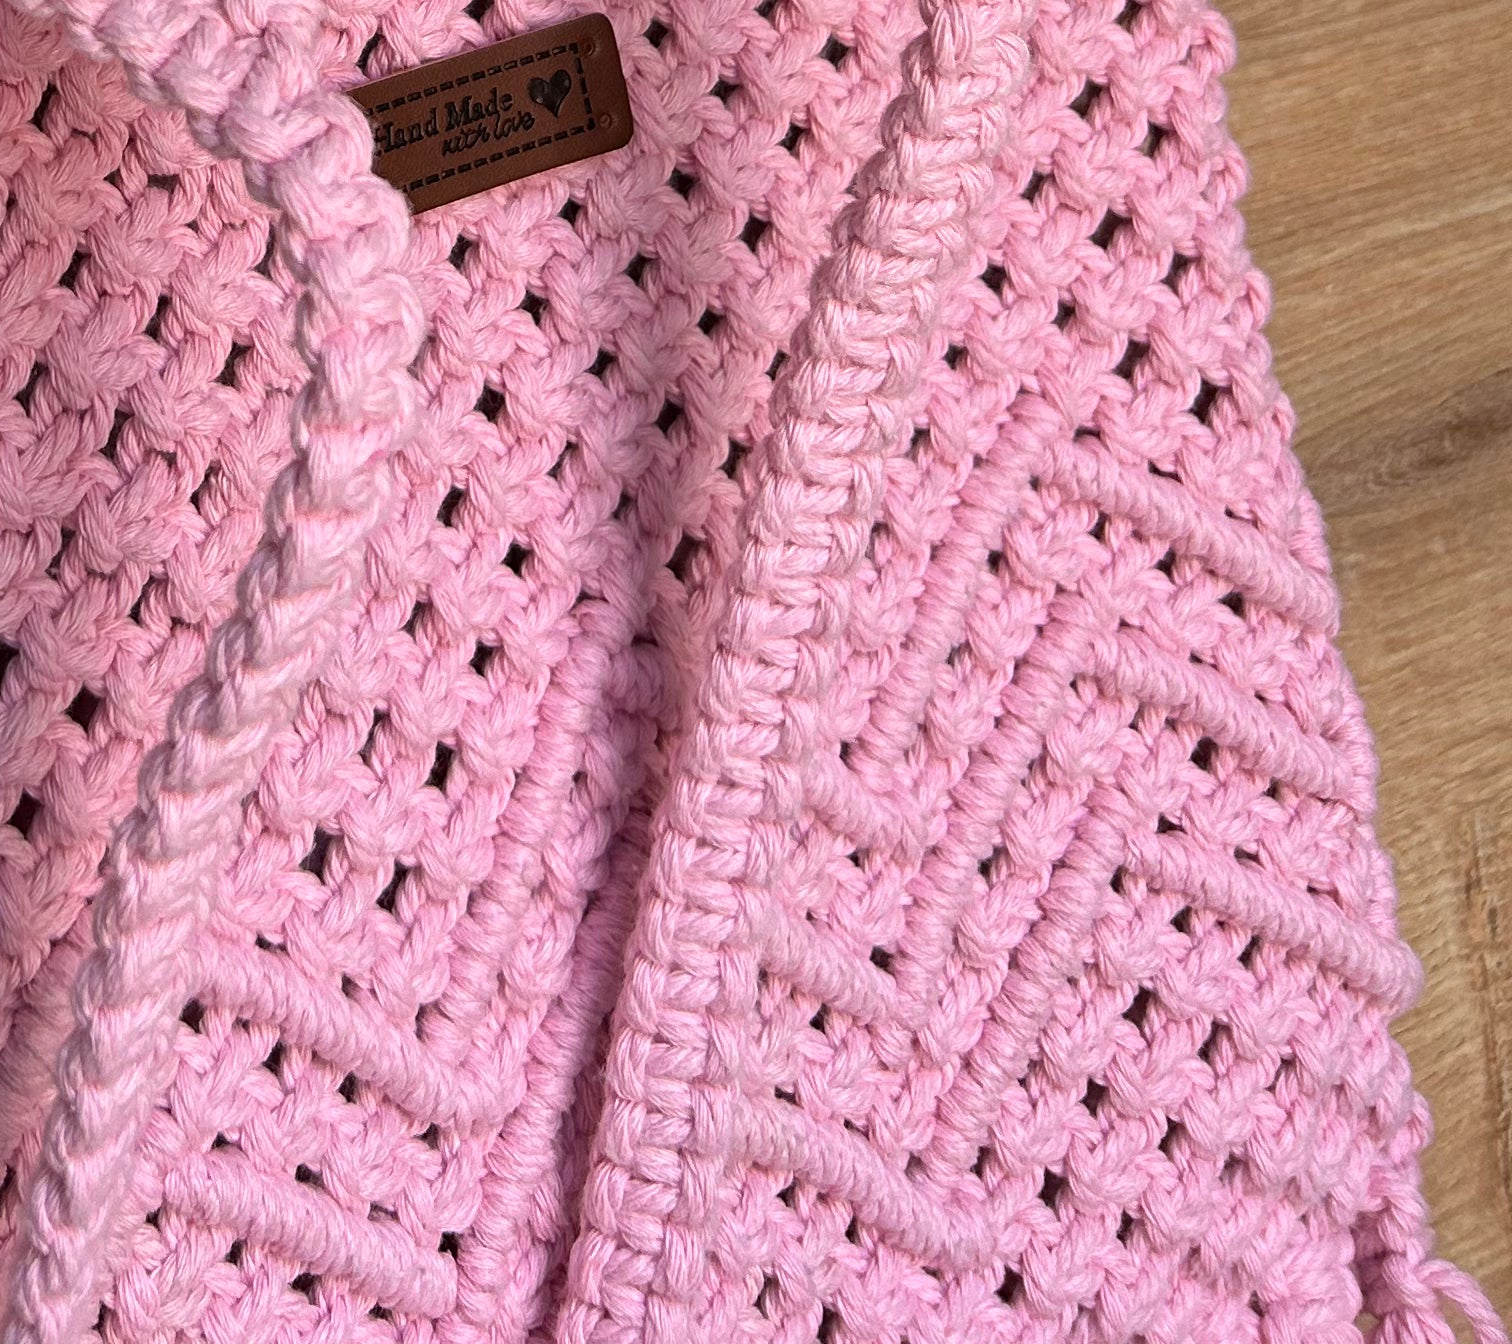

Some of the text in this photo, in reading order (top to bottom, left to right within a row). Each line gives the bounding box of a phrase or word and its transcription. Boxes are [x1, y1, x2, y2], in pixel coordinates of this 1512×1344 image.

[374, 85, 514, 156] Hand Made
[493, 109, 535, 141] love
